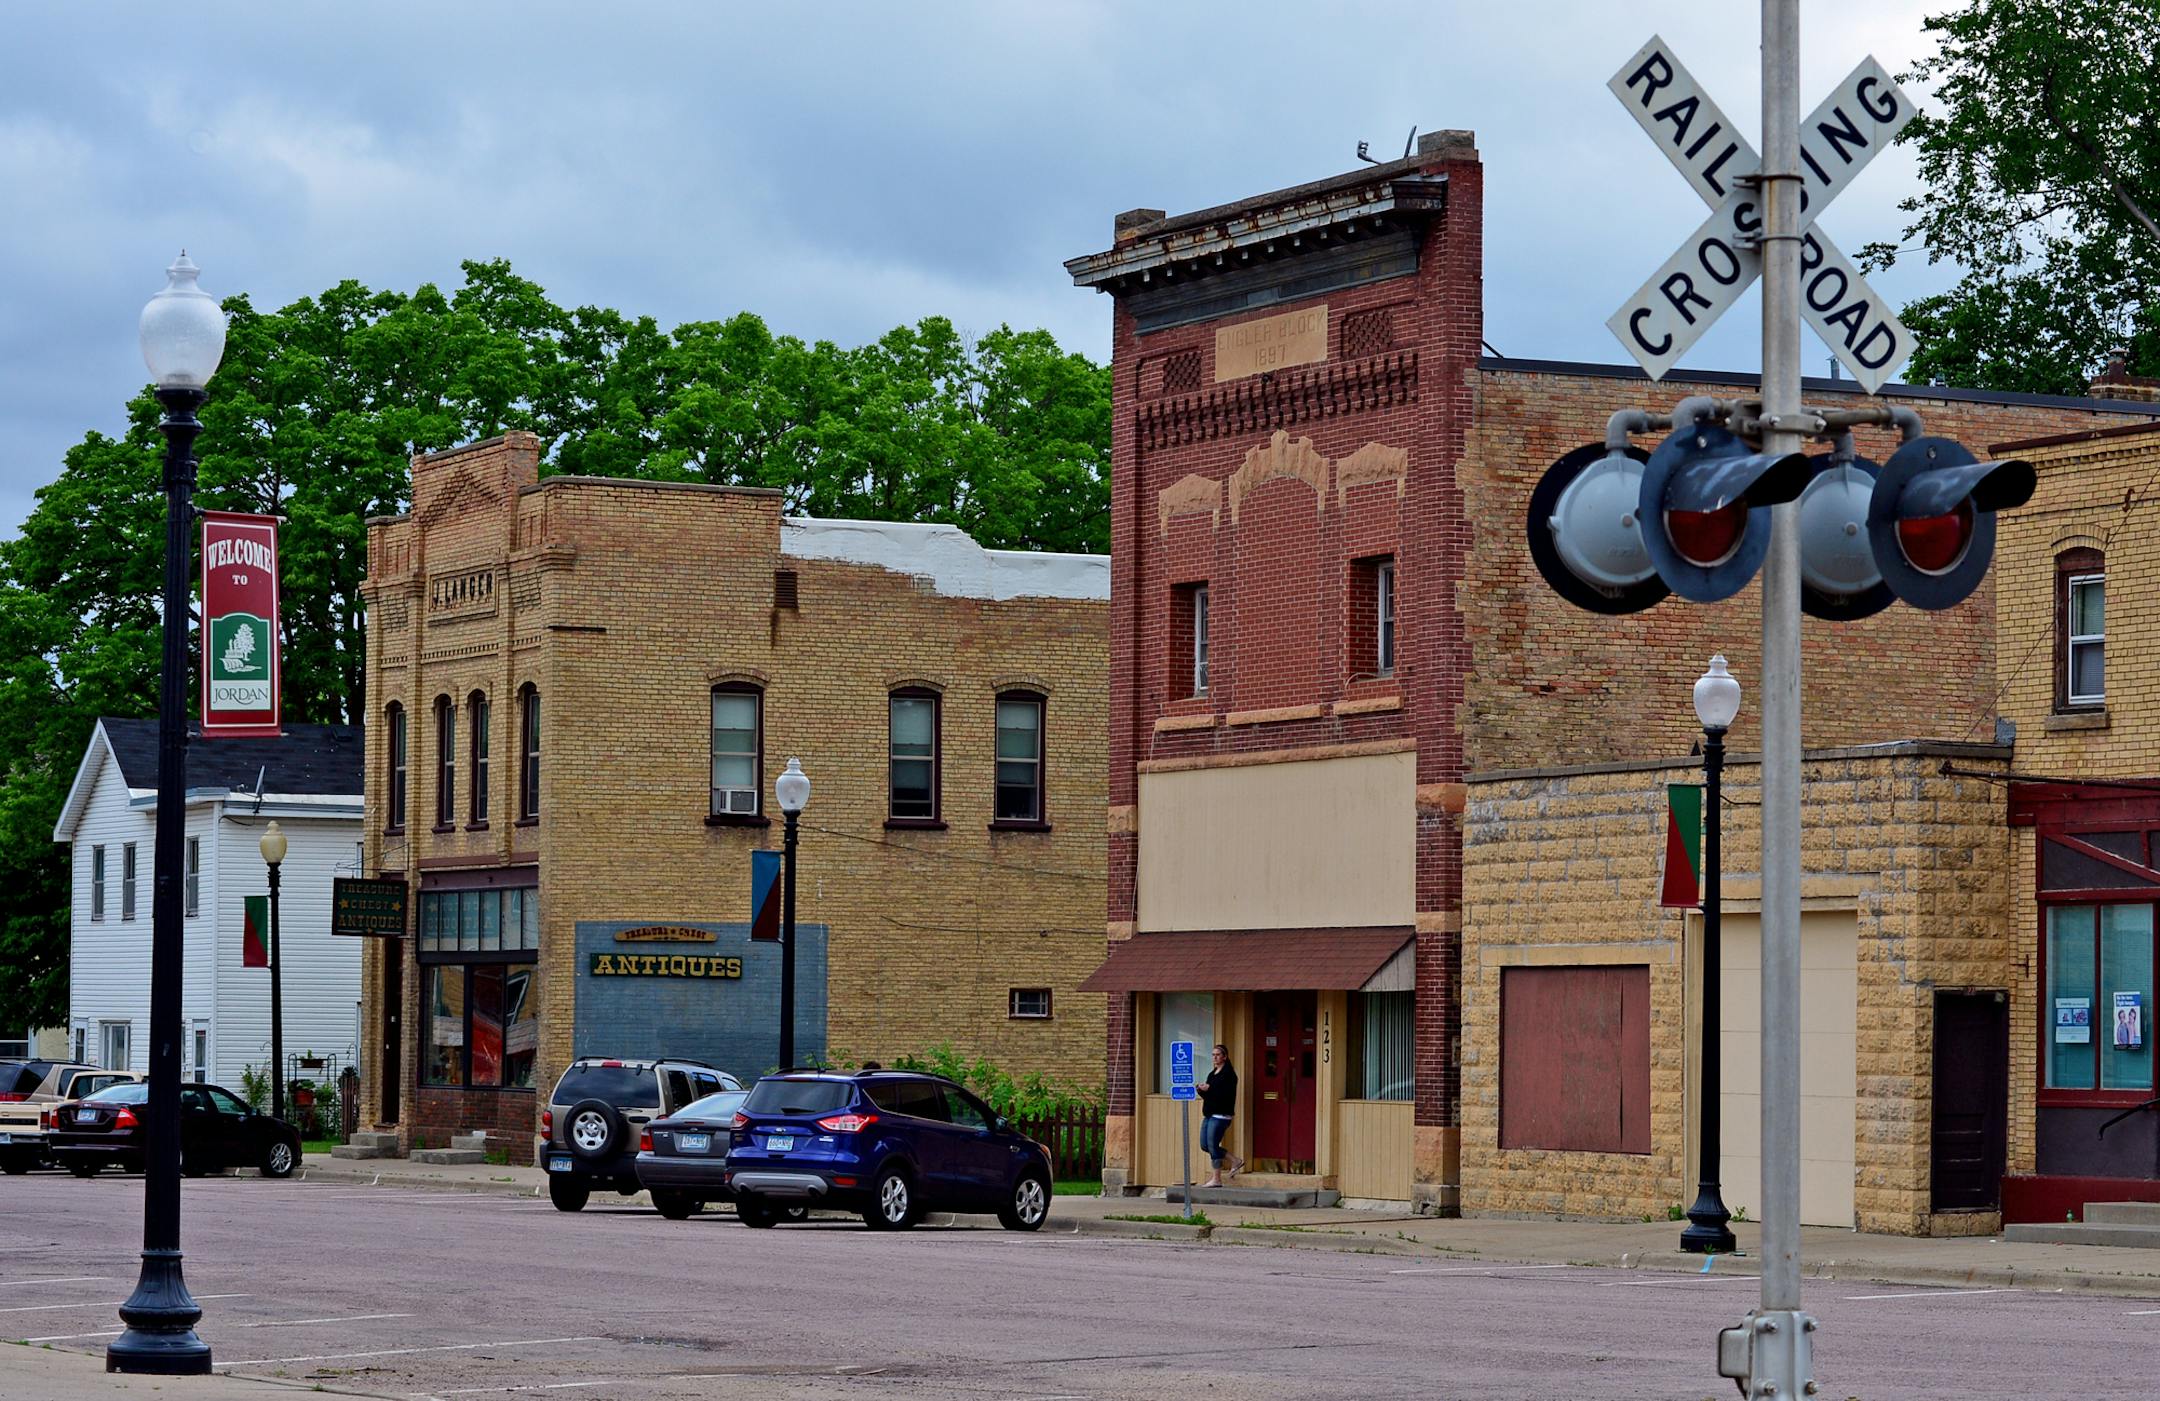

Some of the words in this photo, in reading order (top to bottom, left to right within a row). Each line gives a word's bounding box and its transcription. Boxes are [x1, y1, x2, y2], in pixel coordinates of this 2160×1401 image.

[1218, 323, 1272, 351] ENGLER
[1280, 312, 1326, 338] BLOCK
[207, 538, 272, 574] WELCOME
[232, 574, 248, 586] TO
[212, 687, 269, 706] JORDAN
[342, 883, 401, 895] TREASURE
[351, 899, 389, 910] CHEST
[338, 914, 402, 928] ANTIQUES
[593, 954, 742, 978] ANTIQUES
